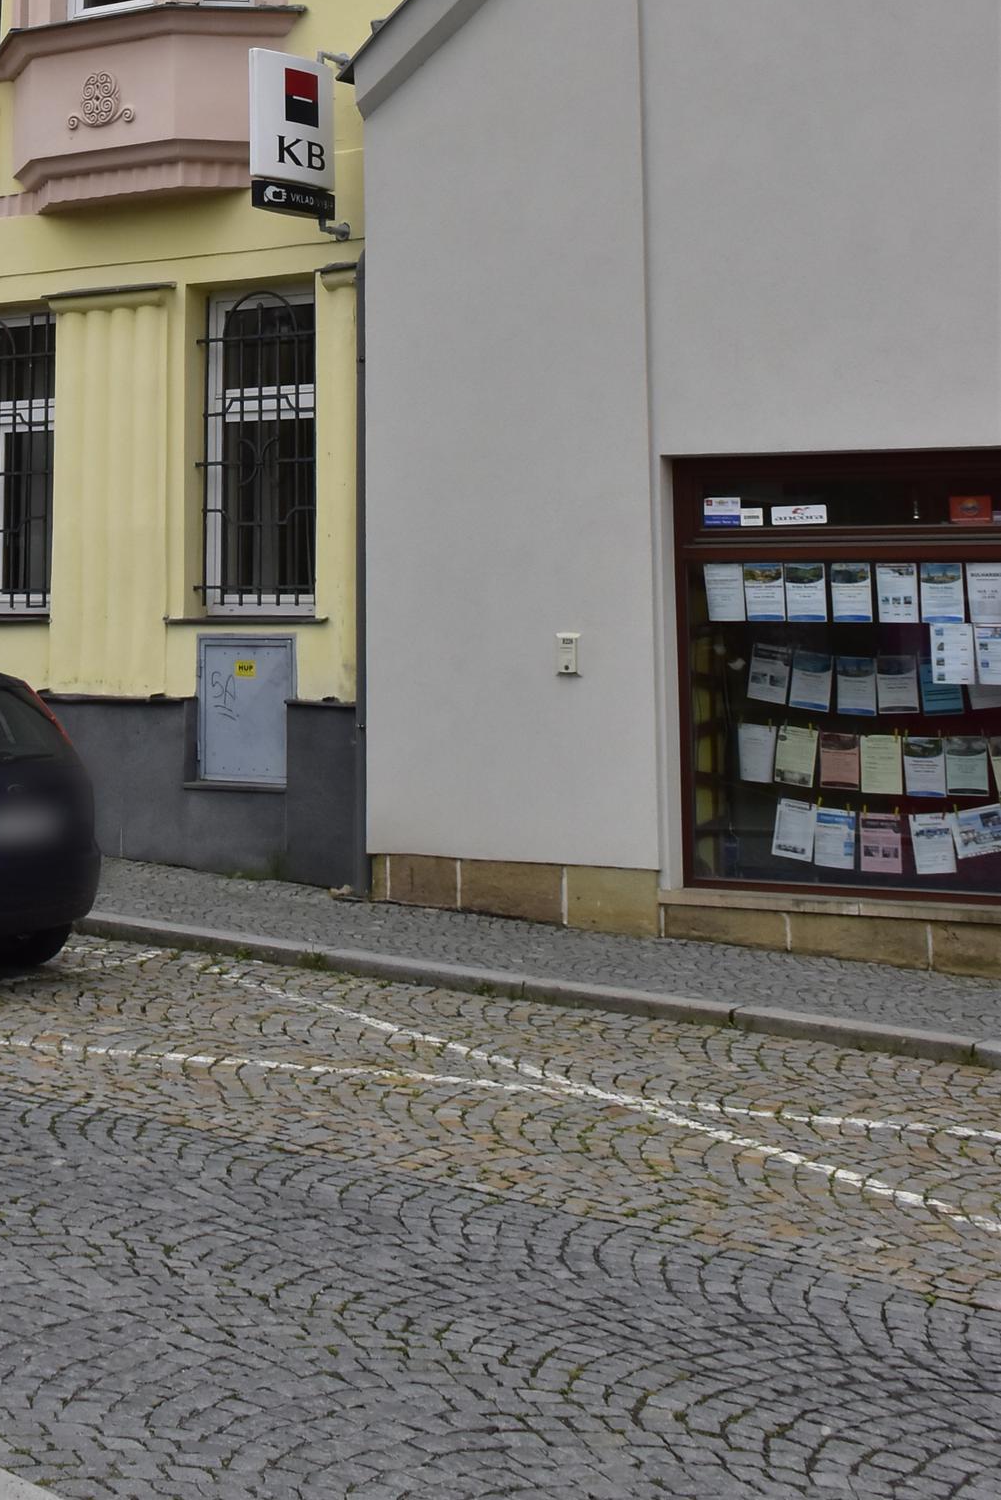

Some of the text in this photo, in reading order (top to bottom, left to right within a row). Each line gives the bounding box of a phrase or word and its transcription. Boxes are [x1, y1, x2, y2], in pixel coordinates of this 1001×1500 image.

[276, 134, 326, 172] KB
[290, 192, 314, 206] VKLAD
[238, 664, 254, 673] HUP
